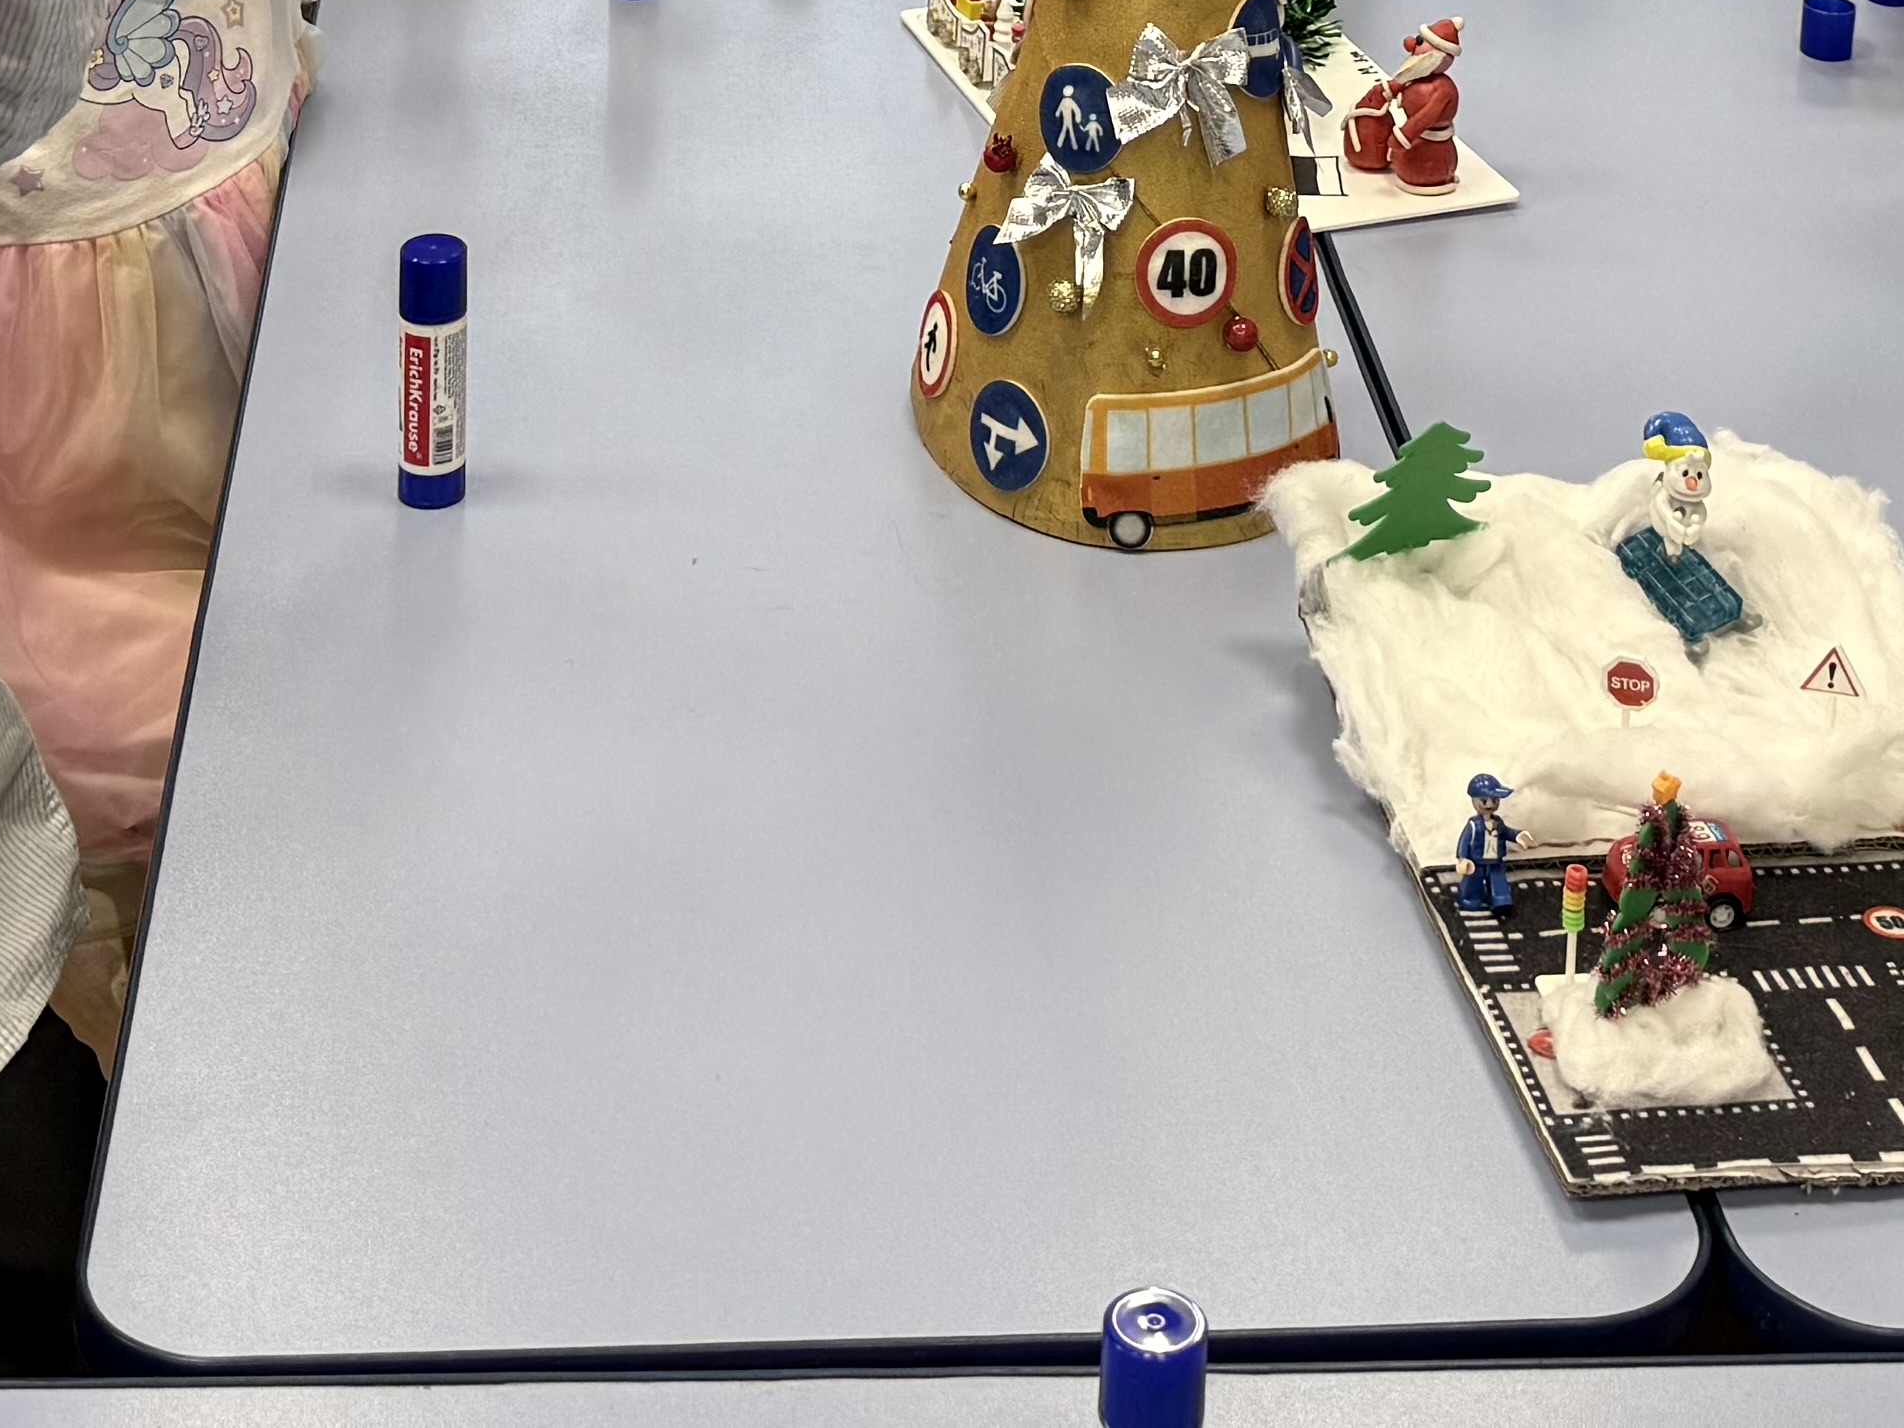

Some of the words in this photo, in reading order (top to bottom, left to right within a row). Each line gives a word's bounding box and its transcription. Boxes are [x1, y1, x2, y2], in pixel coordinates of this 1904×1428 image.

[1156, 248, 1217, 298] 40
[408, 347, 424, 453] ErichKrause
[1610, 675, 1651, 693] STOP
